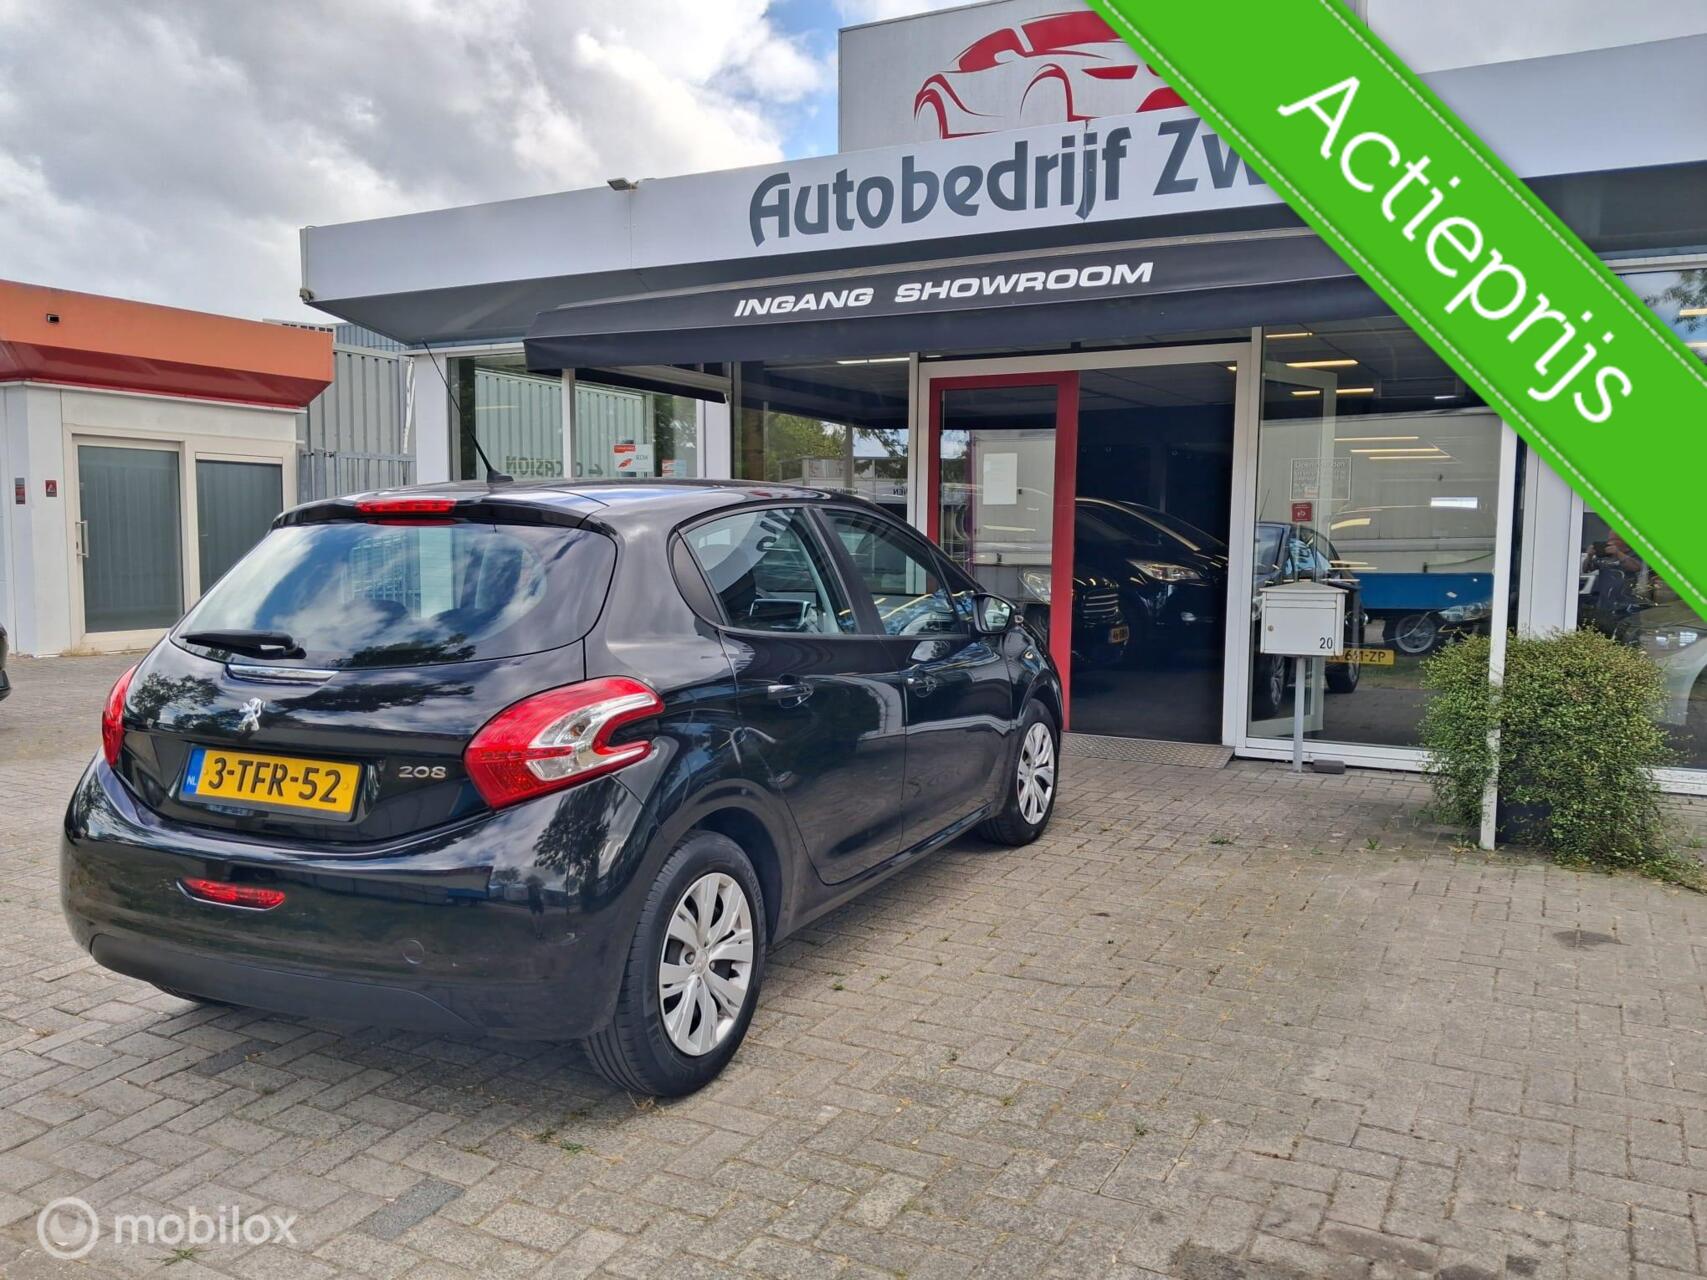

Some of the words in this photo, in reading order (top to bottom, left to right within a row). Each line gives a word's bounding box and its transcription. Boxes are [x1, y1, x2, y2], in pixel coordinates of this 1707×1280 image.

[749, 125, 1131, 247] Autobedrijf
[734, 287, 874, 316] INGANG
[895, 262, 1153, 302] SHOWROOM
[1319, 637, 1333, 650] 20
[187, 775, 197, 786] NL
[208, 757, 341, 804] 3-TFR-52
[398, 765, 447, 779] 208
